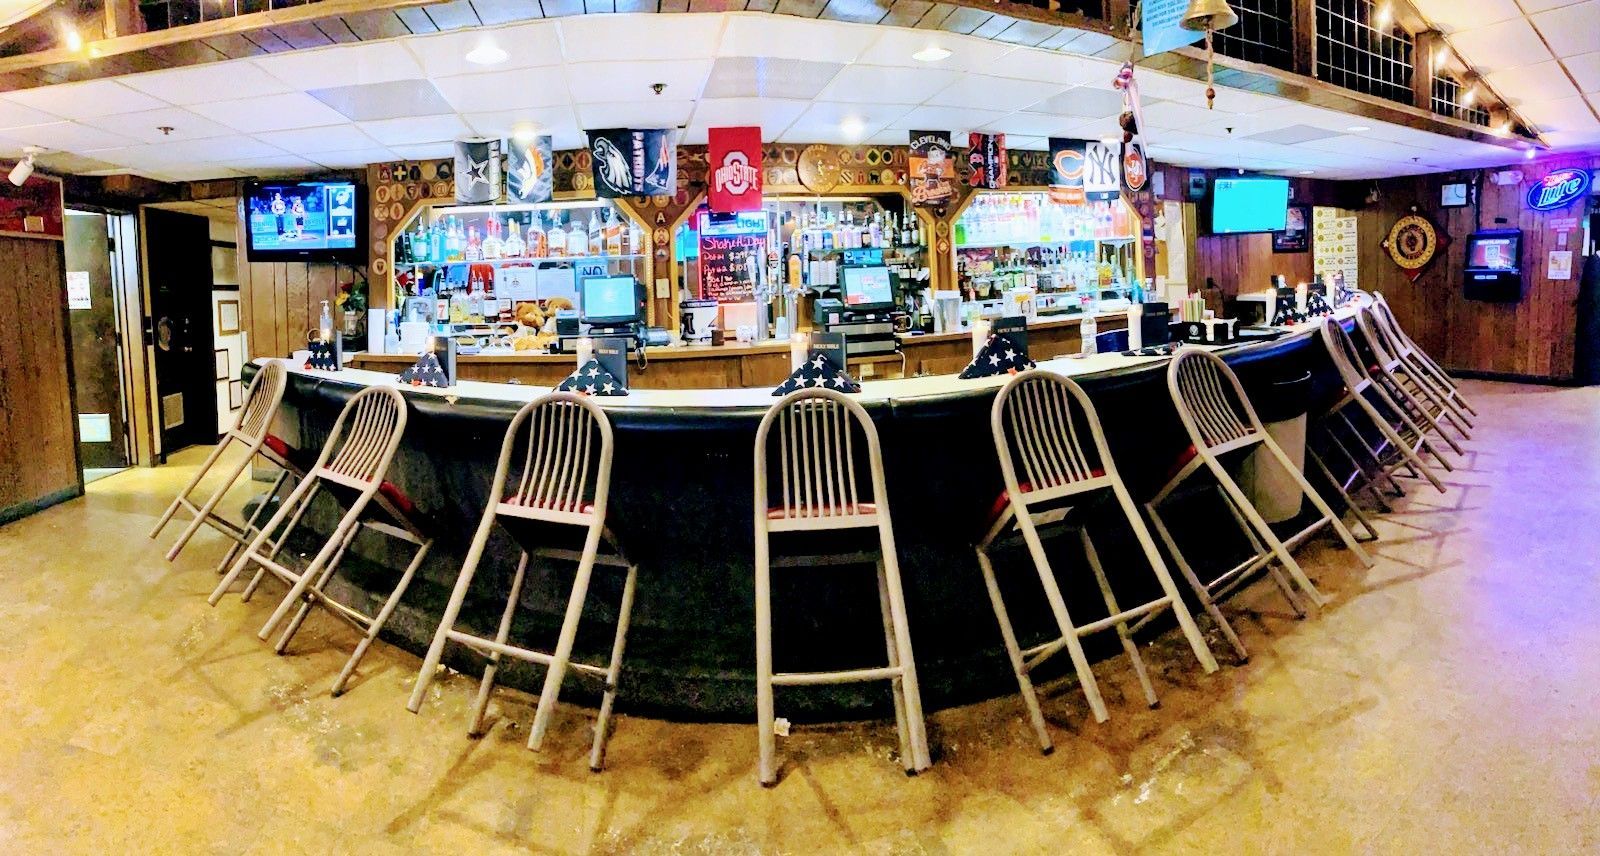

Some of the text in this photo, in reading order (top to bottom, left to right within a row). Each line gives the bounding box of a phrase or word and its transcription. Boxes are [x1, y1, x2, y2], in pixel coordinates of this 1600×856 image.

[910, 135, 952, 151] CLEVELAND
[632, 131, 645, 192] PATRIOTS
[1088, 144, 1116, 185] NY
[582, 265, 603, 276] NO
